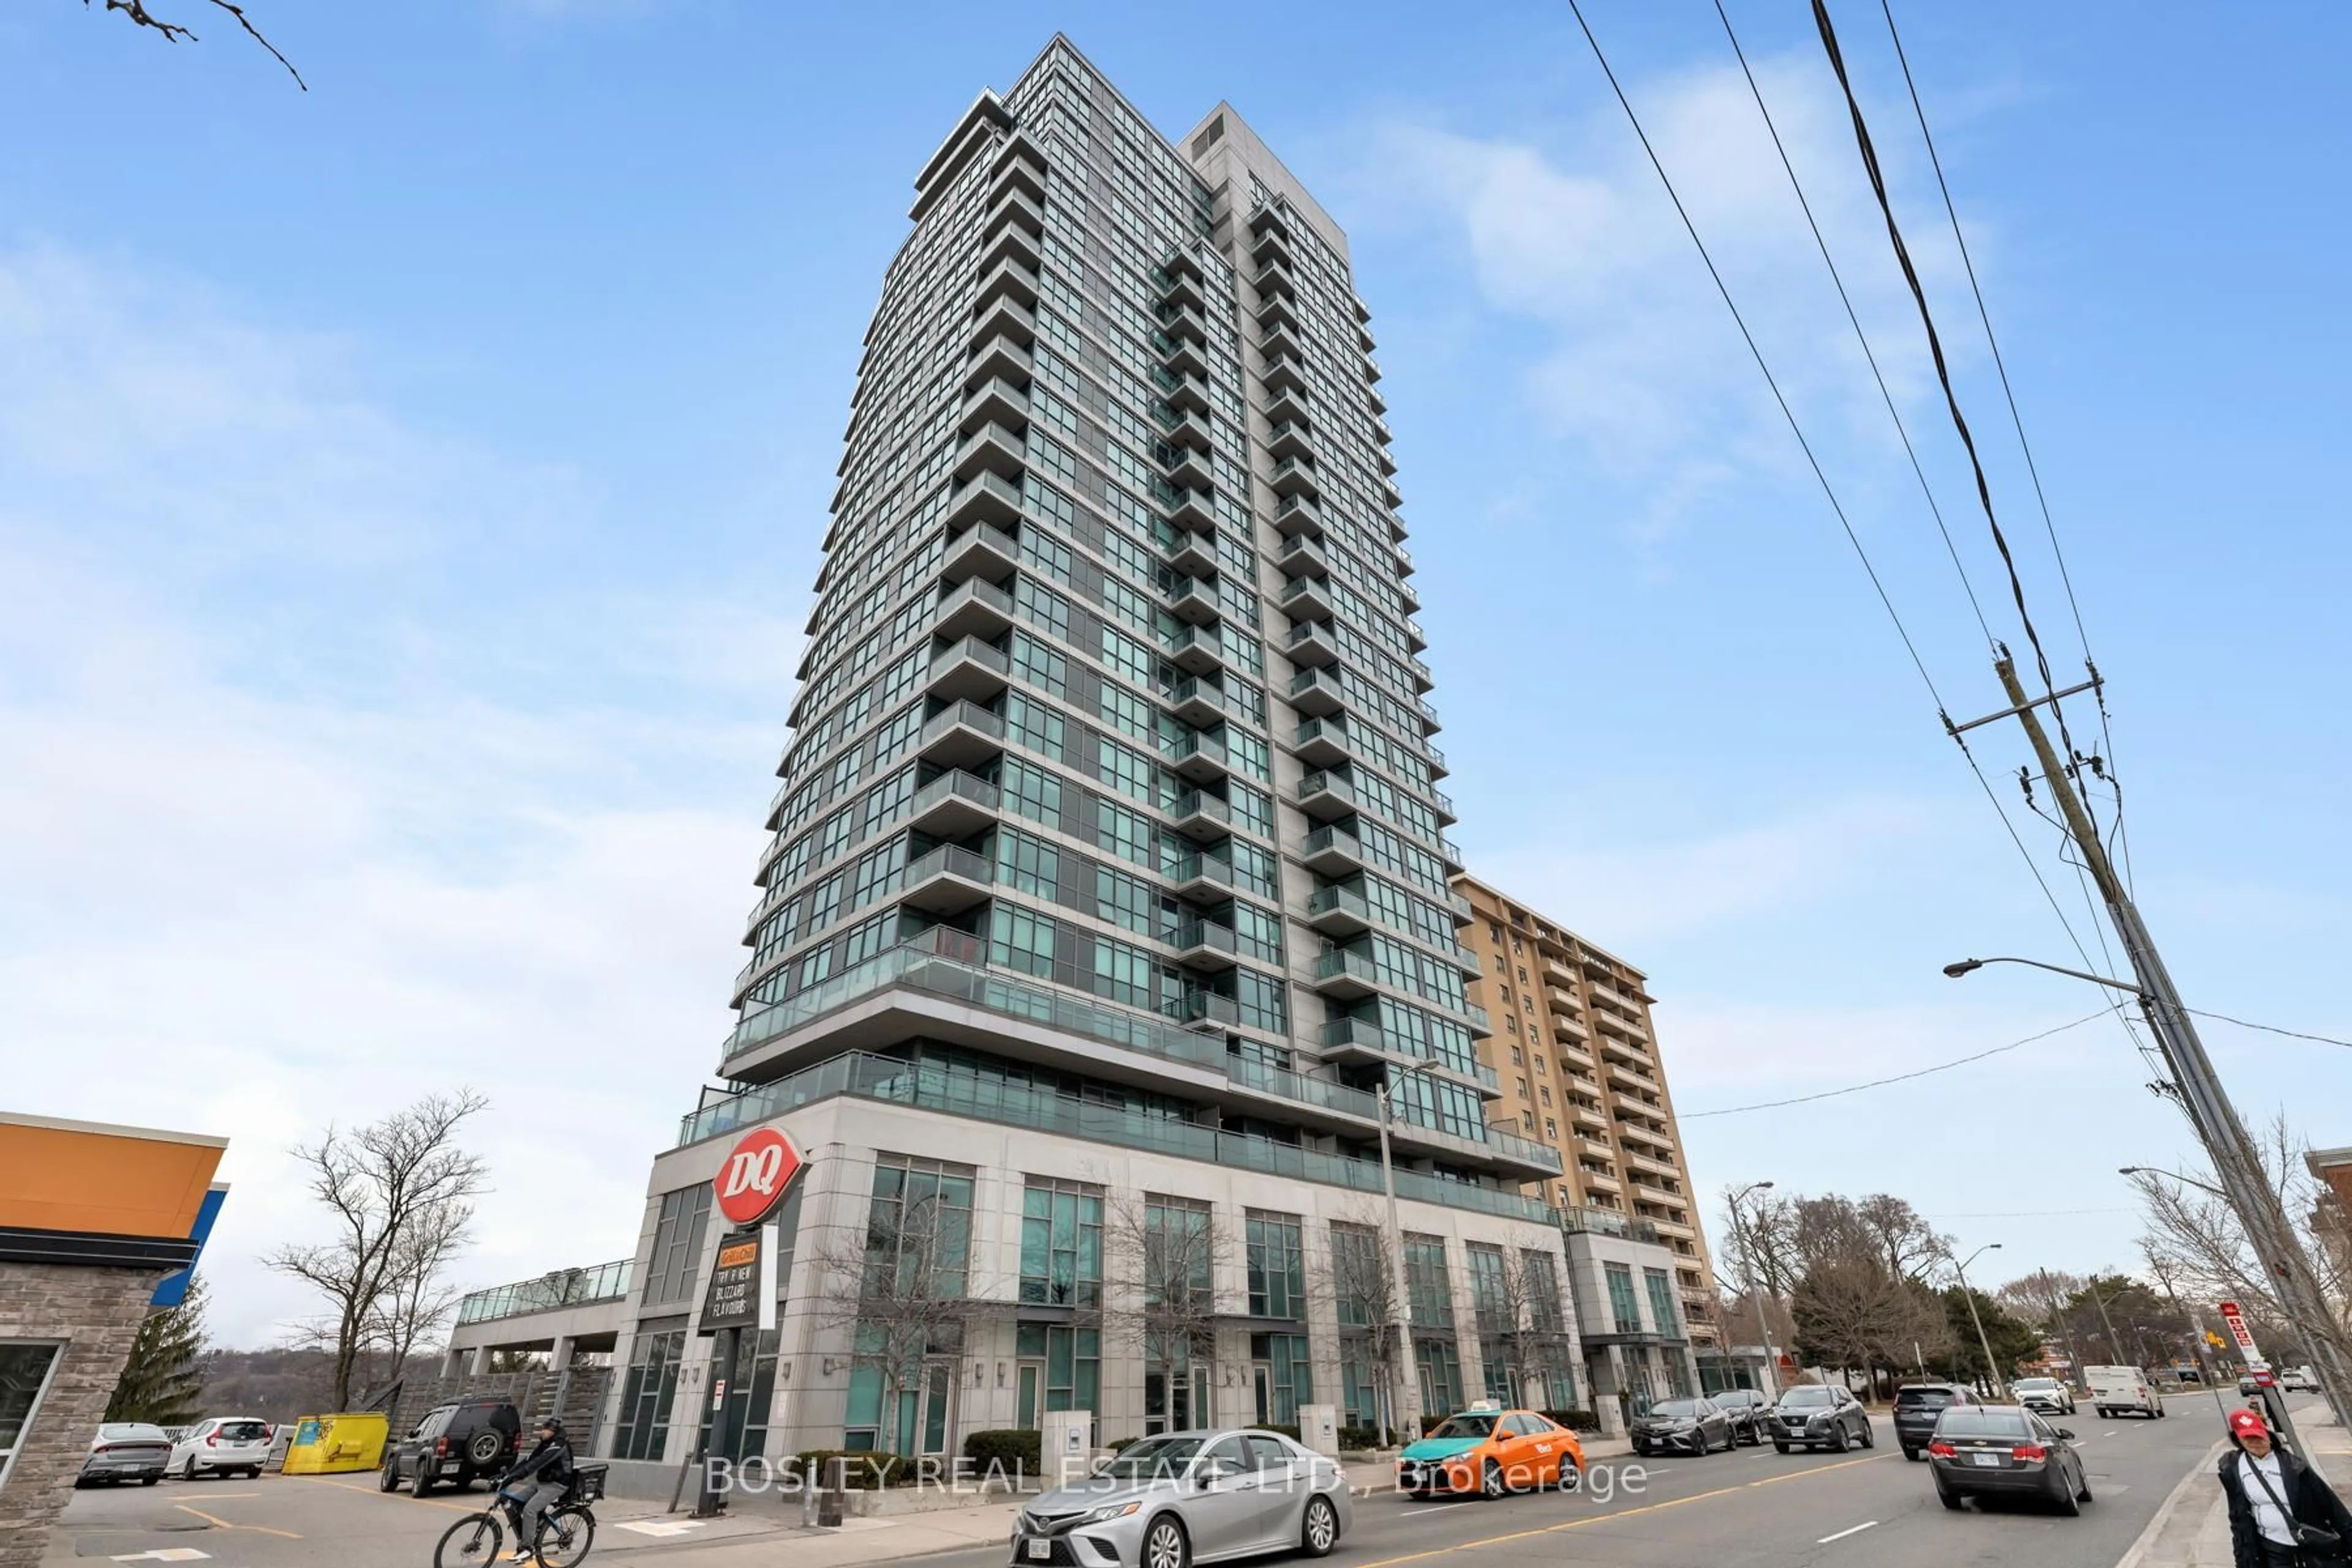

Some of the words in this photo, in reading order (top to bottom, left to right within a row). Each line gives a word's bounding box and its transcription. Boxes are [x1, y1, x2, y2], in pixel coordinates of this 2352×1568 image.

[723, 1144, 782, 1198] DQ
[717, 1270, 729, 1284] TRY
[738, 1265, 751, 1280] NEW
[715, 1283, 745, 1301] BLIZZARD
[712, 1298, 747, 1317] FLAVOURS
